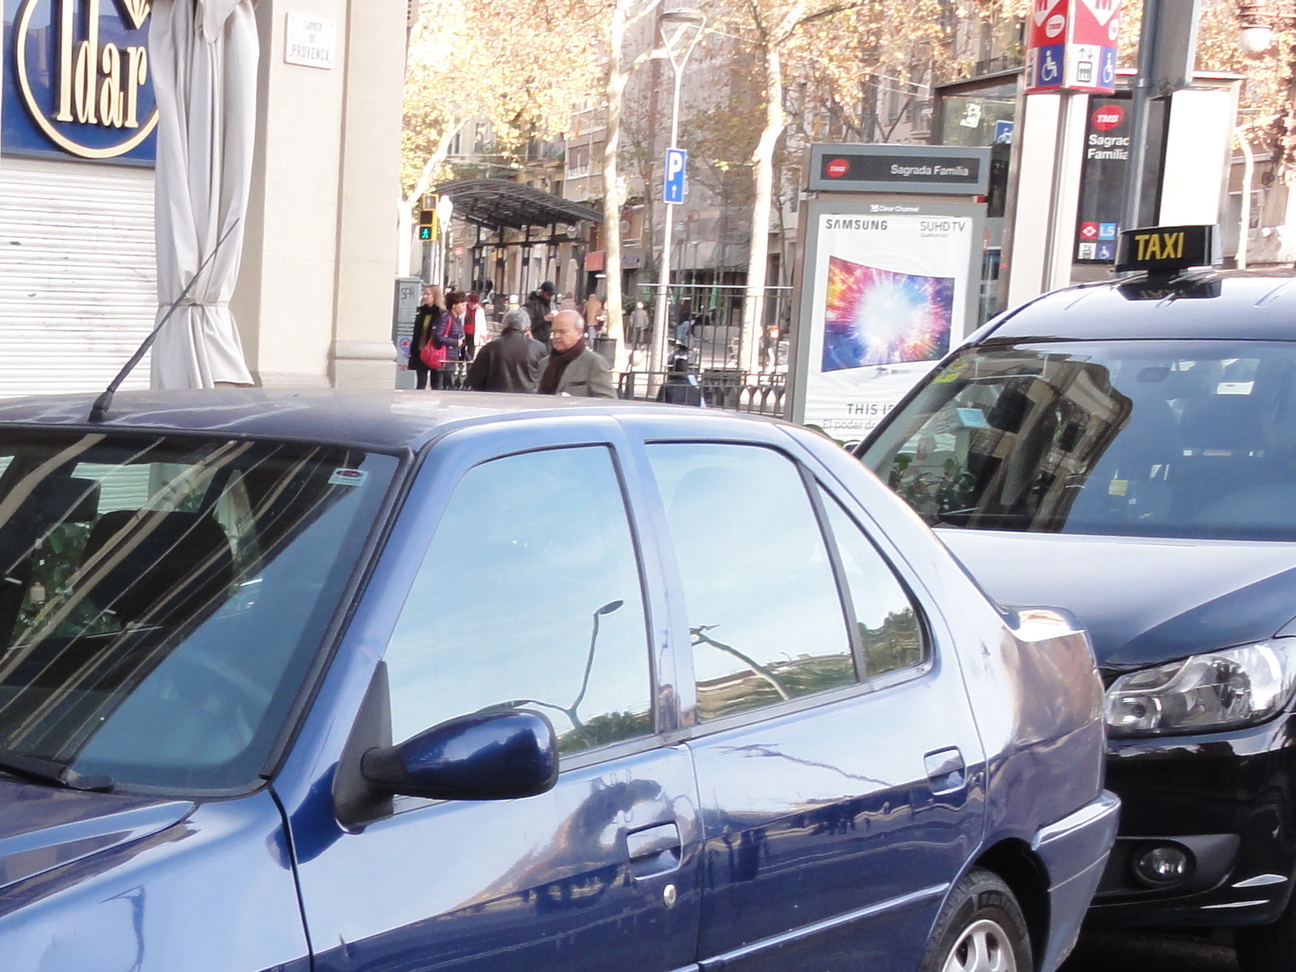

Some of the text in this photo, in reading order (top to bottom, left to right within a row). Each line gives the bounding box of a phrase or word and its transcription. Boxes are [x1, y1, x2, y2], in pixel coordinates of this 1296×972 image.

[1097, 114, 1119, 123] TMB
[667, 152, 683, 181] P
[890, 164, 932, 177] Sagrada
[825, 219, 888, 231] SAMSUNG
[1099, 226, 1115, 237] L5
[1135, 232, 1185, 261] TAXI
[846, 403, 878, 416] THIS
